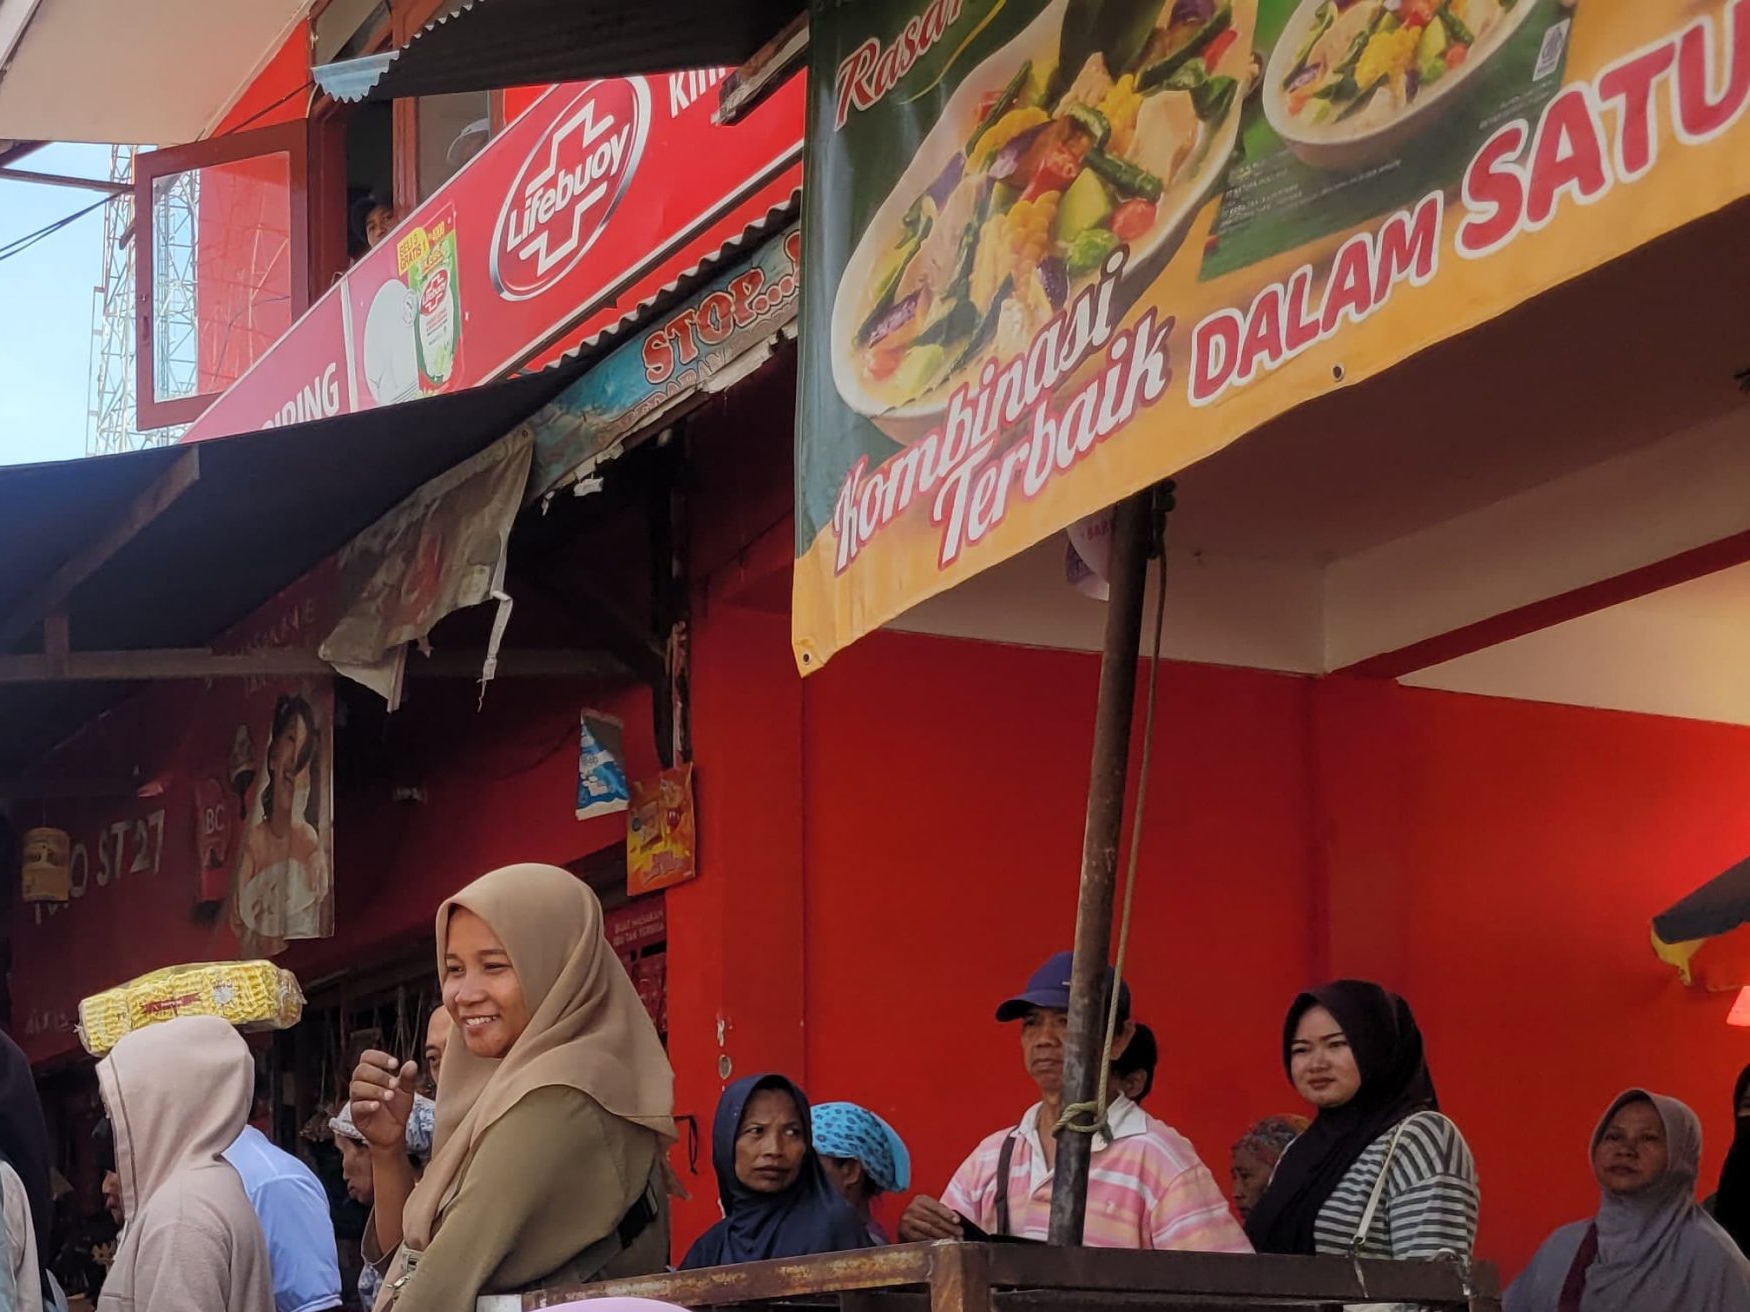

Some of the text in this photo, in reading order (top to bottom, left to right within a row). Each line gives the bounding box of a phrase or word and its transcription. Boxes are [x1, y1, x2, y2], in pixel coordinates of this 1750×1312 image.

[507, 123, 630, 252] Lifebuoy
[1188, 0, 1750, 406] DALAM SATU
[832, 244, 1130, 576] Kombinasi
[934, 307, 1175, 568] Terbaik
